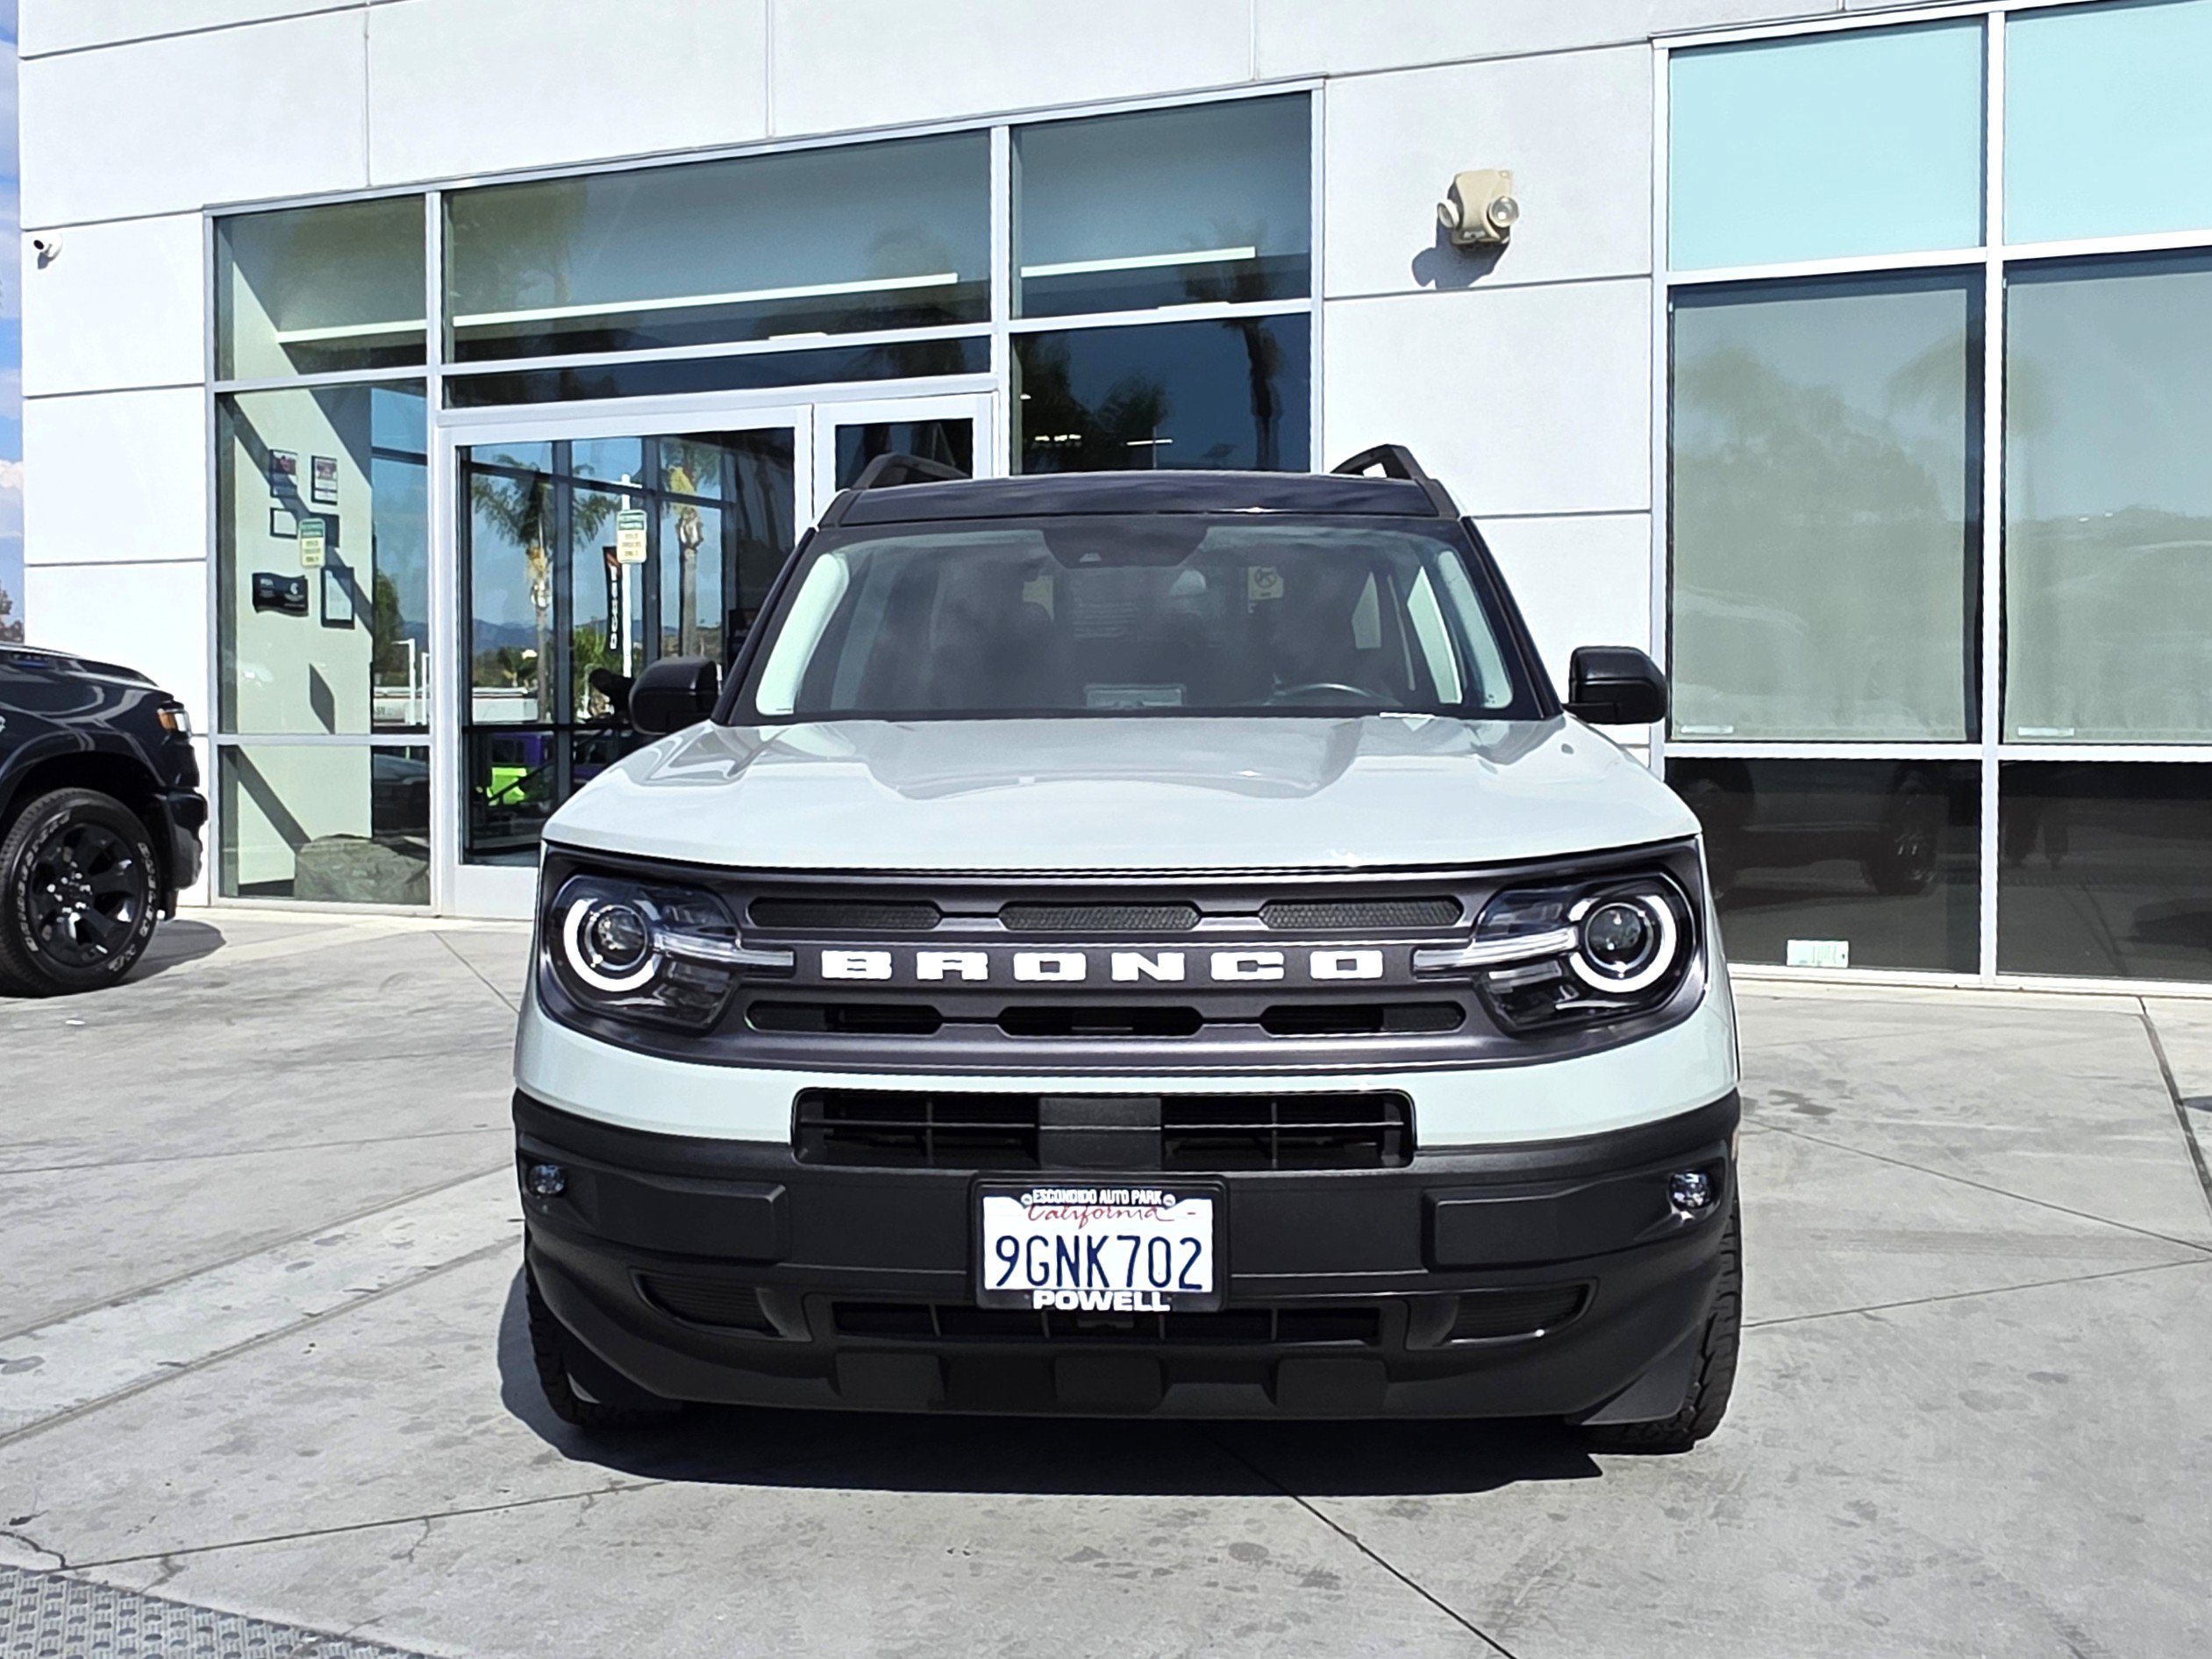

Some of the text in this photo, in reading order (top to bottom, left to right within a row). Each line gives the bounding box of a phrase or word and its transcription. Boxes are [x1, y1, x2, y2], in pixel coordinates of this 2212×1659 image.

[821, 950, 1384, 982] BRONCO
[1032, 1189, 1162, 1205] ESCONDIDO AUTO PARK
[1028, 1205, 1175, 1229] California
[995, 1234, 1202, 1290] 9GNK702
[1033, 1291, 1170, 1312] POWELL
